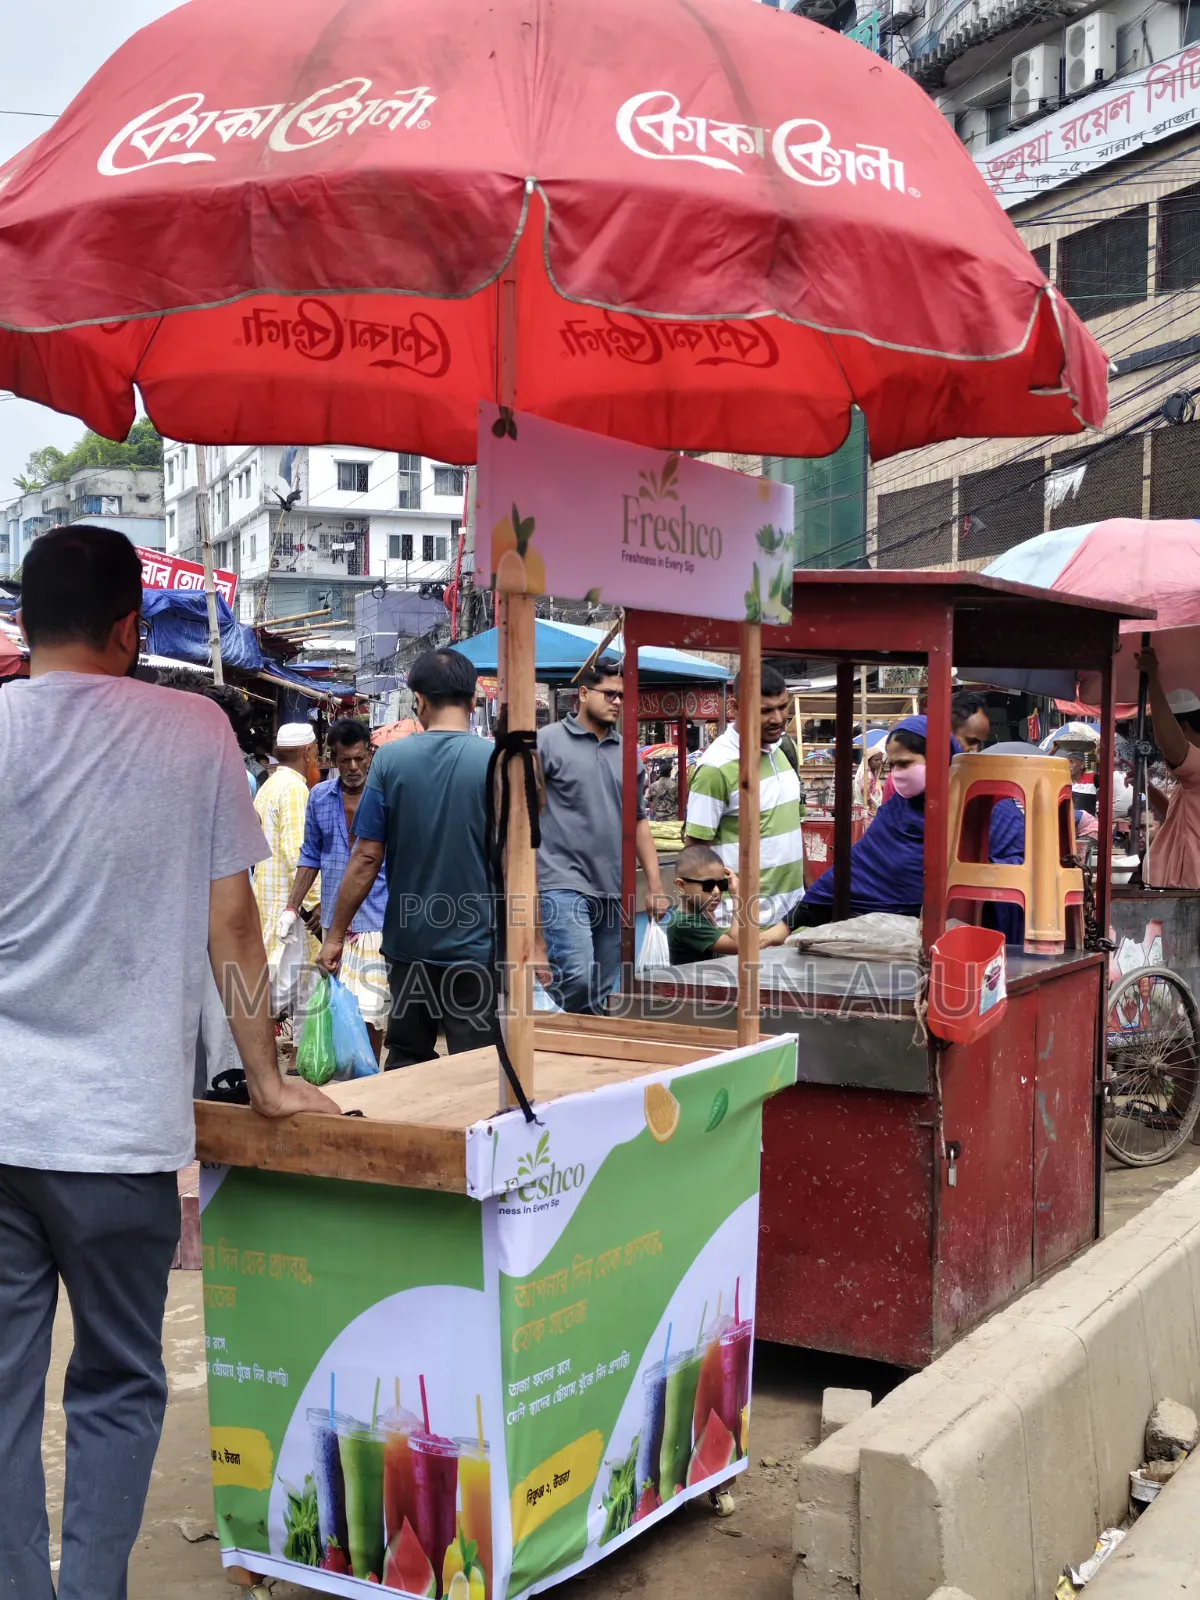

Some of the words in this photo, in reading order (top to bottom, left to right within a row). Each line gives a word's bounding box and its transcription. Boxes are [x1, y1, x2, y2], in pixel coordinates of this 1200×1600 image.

[1059, 90, 1136, 150] রয়েল
[622, 493, 723, 561] Freshco
[621, 549, 657, 567] Freshness
[665, 557, 683, 574] Every
[684, 560, 695, 575] Sip
[533, 1202, 550, 1213] Every
[550, 1198, 560, 1208] Sip
[512, 1317, 546, 1352] হোক
[508, 1376, 531, 1397] তাজা
